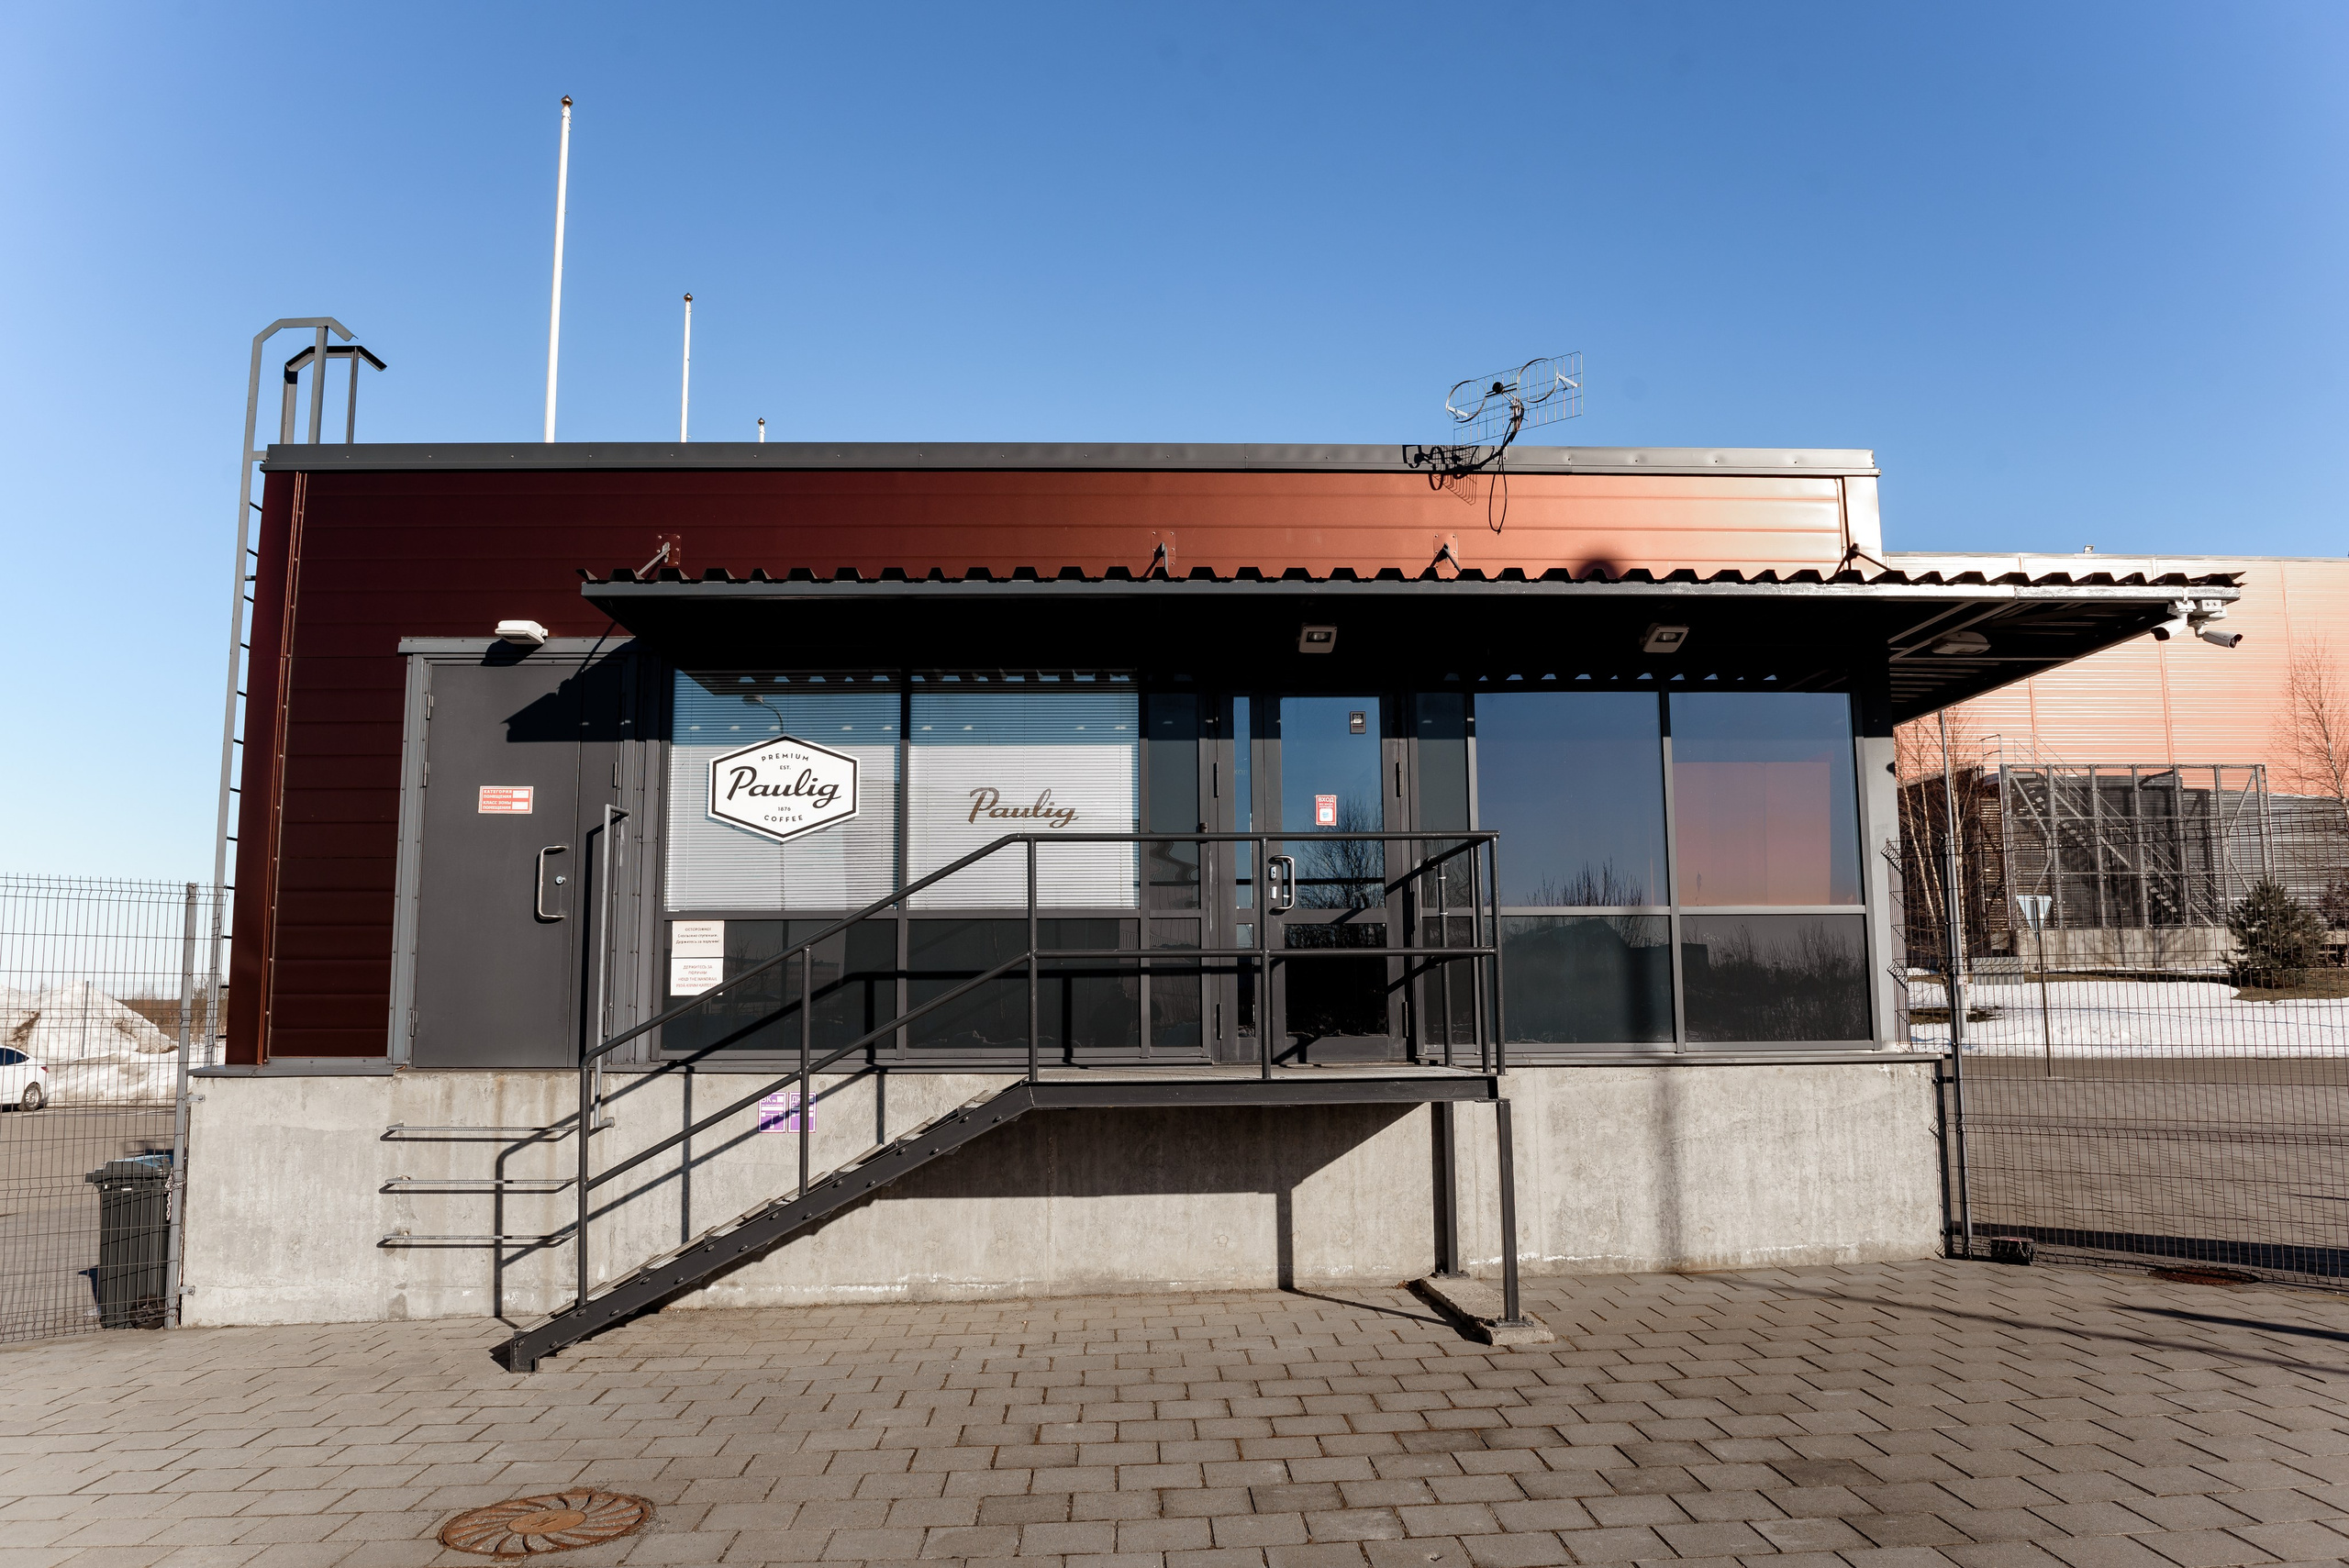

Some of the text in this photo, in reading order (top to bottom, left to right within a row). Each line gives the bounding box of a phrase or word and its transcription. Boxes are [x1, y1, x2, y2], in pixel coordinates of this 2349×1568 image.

[762, 753, 809, 762] PREMIUM
[726, 766, 841, 809] Paulig
[764, 814, 803, 823] COFFEE
[968, 787, 1079, 828] Paulig
